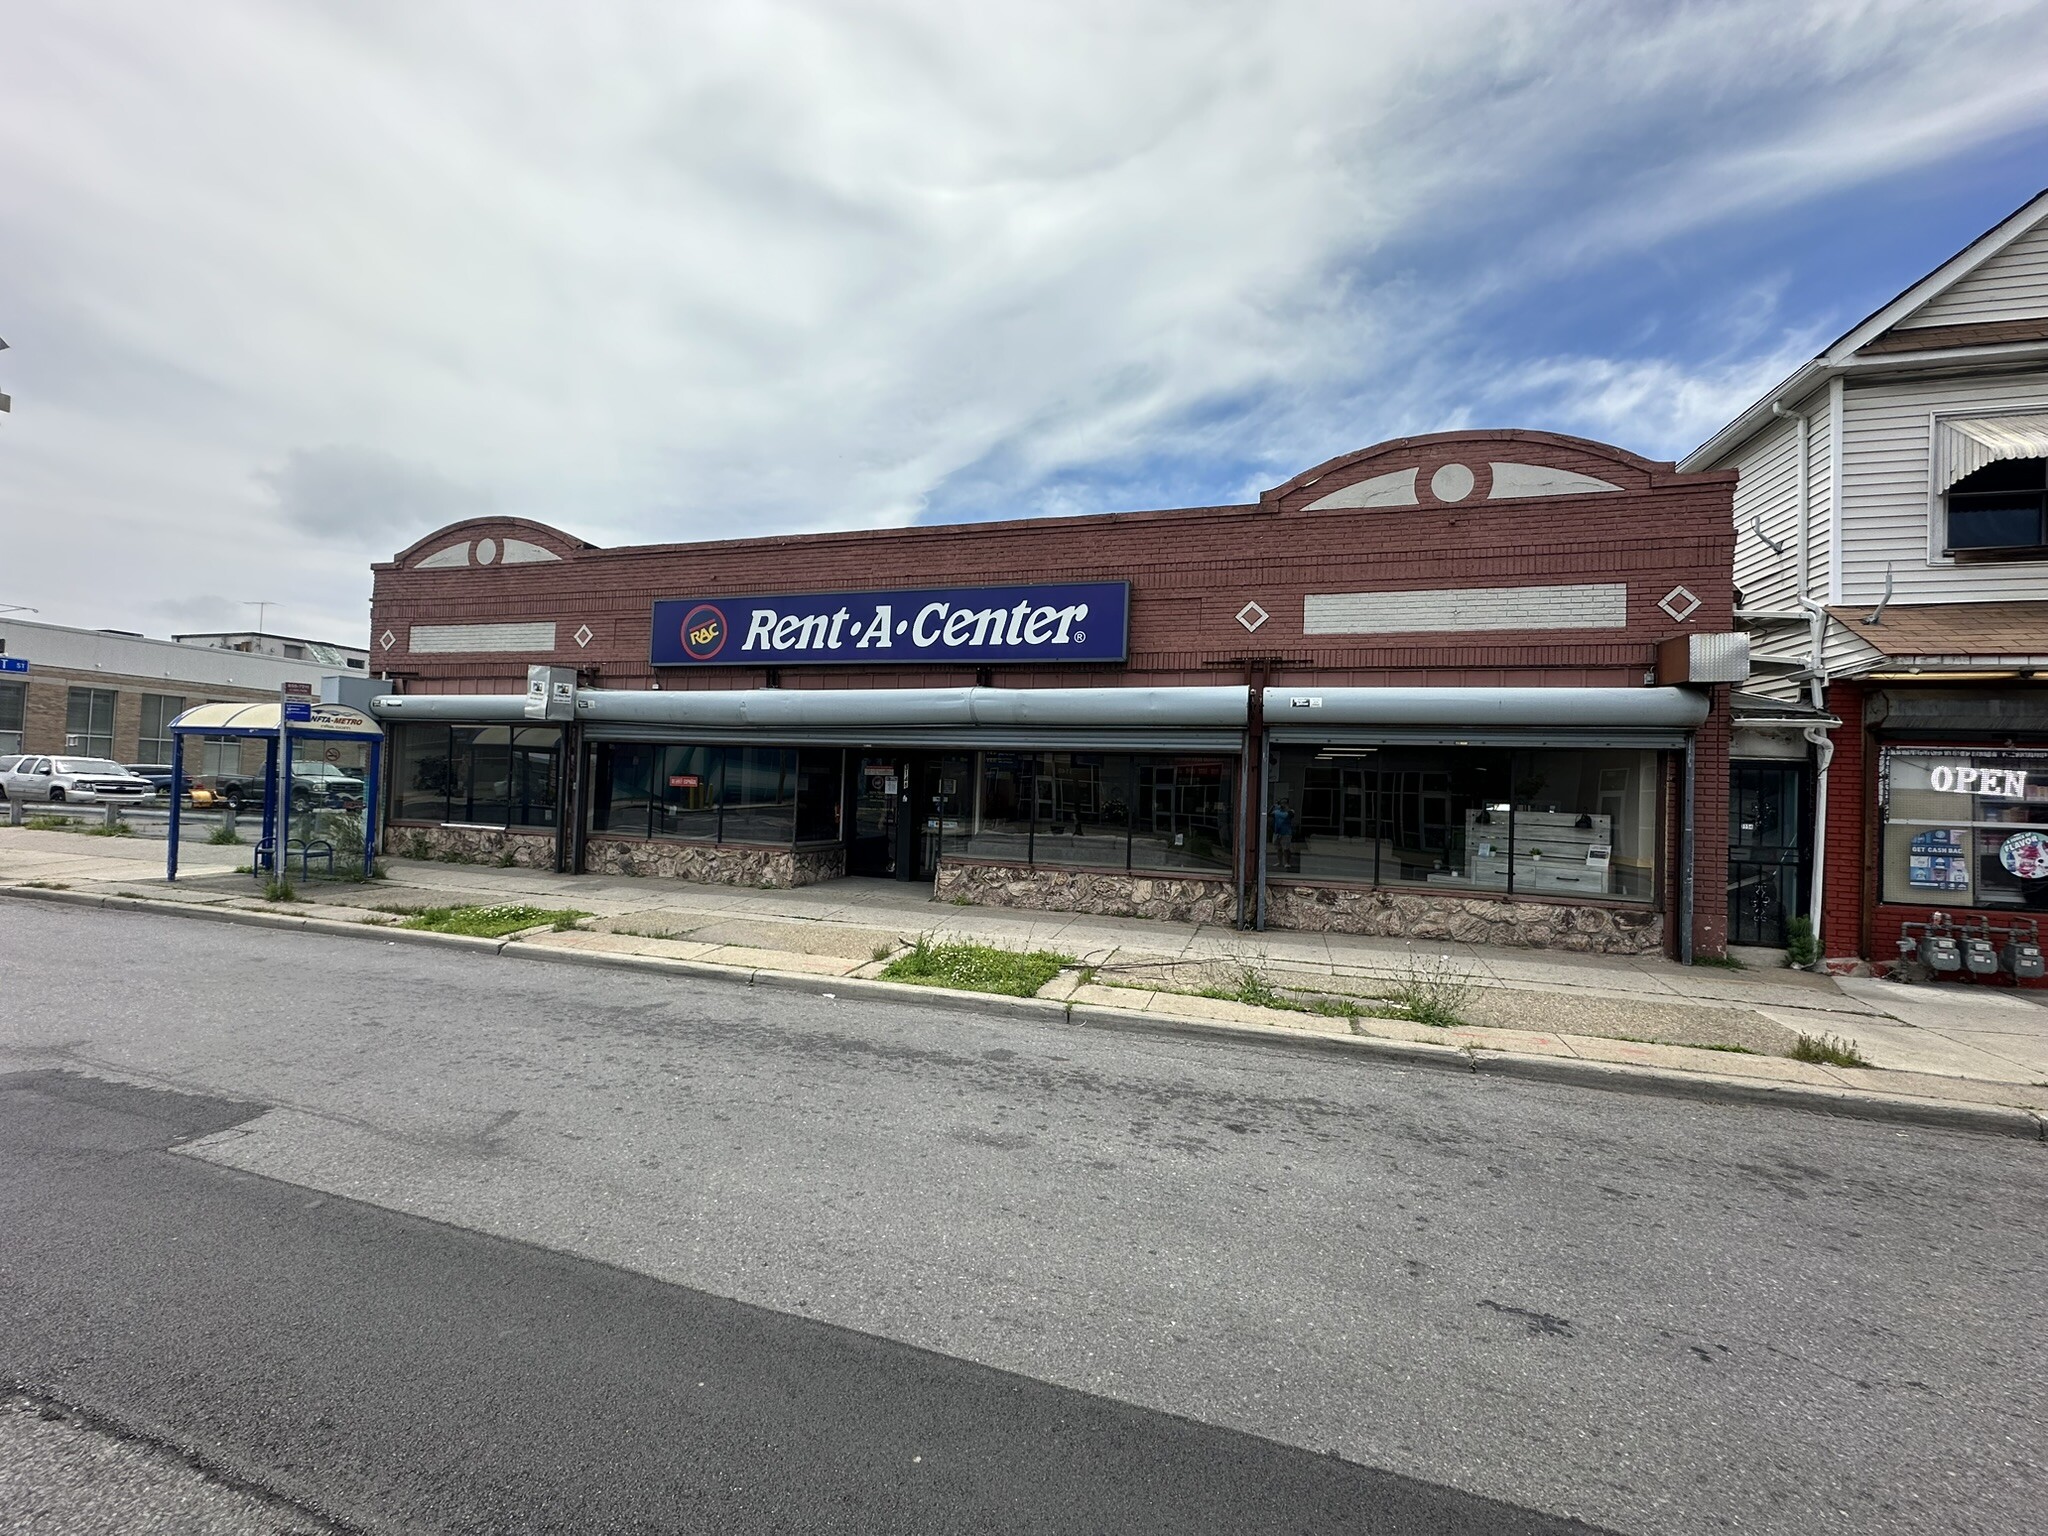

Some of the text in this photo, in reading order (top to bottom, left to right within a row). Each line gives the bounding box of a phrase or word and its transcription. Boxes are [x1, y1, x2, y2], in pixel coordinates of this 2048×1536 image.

[690, 622, 719, 645] RAC
[311, 715, 363, 726] NFTA-METRO
[1930, 765, 2028, 797] OPEN
[2004, 835, 2038, 852] FLAVOR
